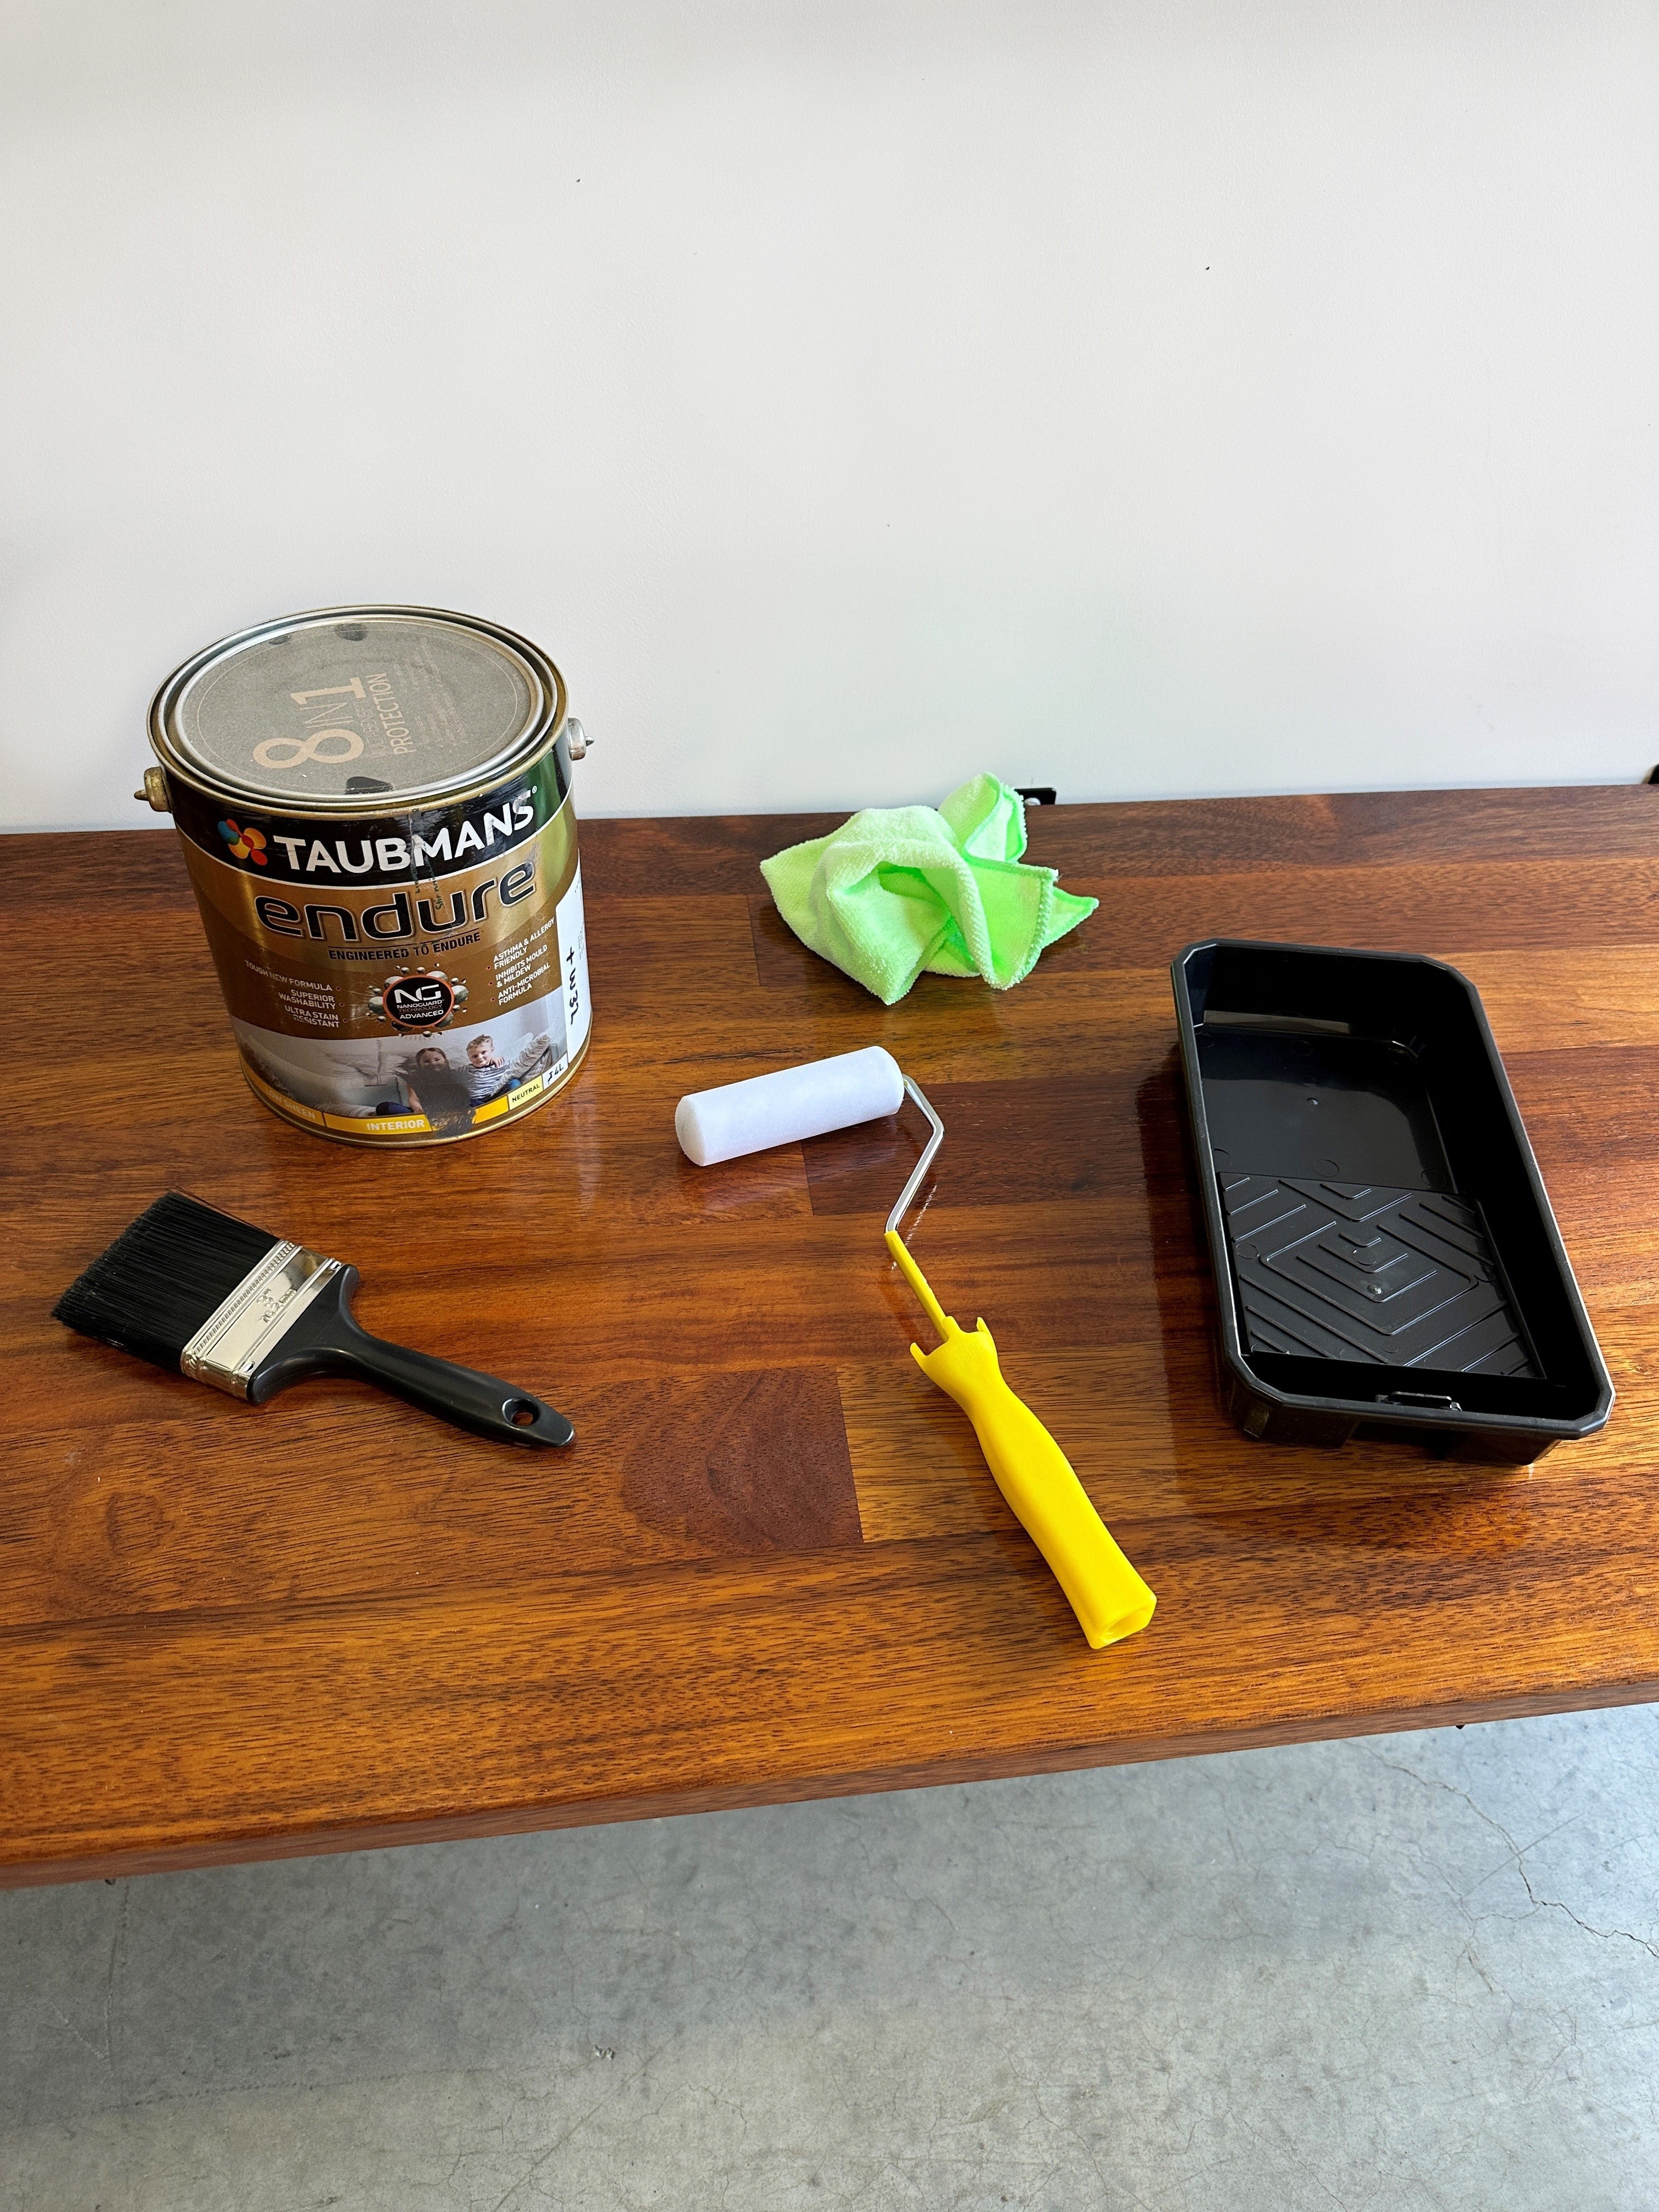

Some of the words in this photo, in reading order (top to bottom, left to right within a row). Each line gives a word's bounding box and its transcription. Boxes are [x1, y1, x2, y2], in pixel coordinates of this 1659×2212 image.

[365, 674, 416, 755] PROTECTION
[273, 790, 535, 874] TAUBMANS
[253, 860, 537, 941] endure
[433, 932, 481, 953] ENDURE
[493, 942, 523, 963] ASTHMA
[530, 917, 555, 943] ALLERGY
[329, 949, 409, 961] ENGINEERED
[413, 944, 430, 957] TO
[494, 947, 528, 970] FRIENDLY
[495, 960, 526, 981] INHIBITS
[526, 944, 548, 964] MOULD
[245, 960, 268, 977] TOUGH
[269, 971, 288, 984] NEW
[289, 978, 333, 991] FORMULA
[498, 962, 551, 999] ANTI-MICROBIAL
[504, 963, 532, 985] MILDEW
[278, 992, 336, 1010] WASHABILITY
[290, 989, 335, 1003] SUPERIOR
[394, 984, 442, 1003] NG
[498, 983, 533, 1006] FORMULA
[284, 1005, 312, 1018] ULTRA
[313, 1012, 339, 1021] STAIN
[397, 1000, 443, 1009] NANOGUARD
[399, 1004, 443, 1013] TECHNOLOGY
[400, 1009, 444, 1019] ADVANCED
[512, 1084, 540, 1103] NEUTRAL
[283, 1100, 315, 1120] SHEEN
[366, 1119, 425, 1131] INTERIOR
